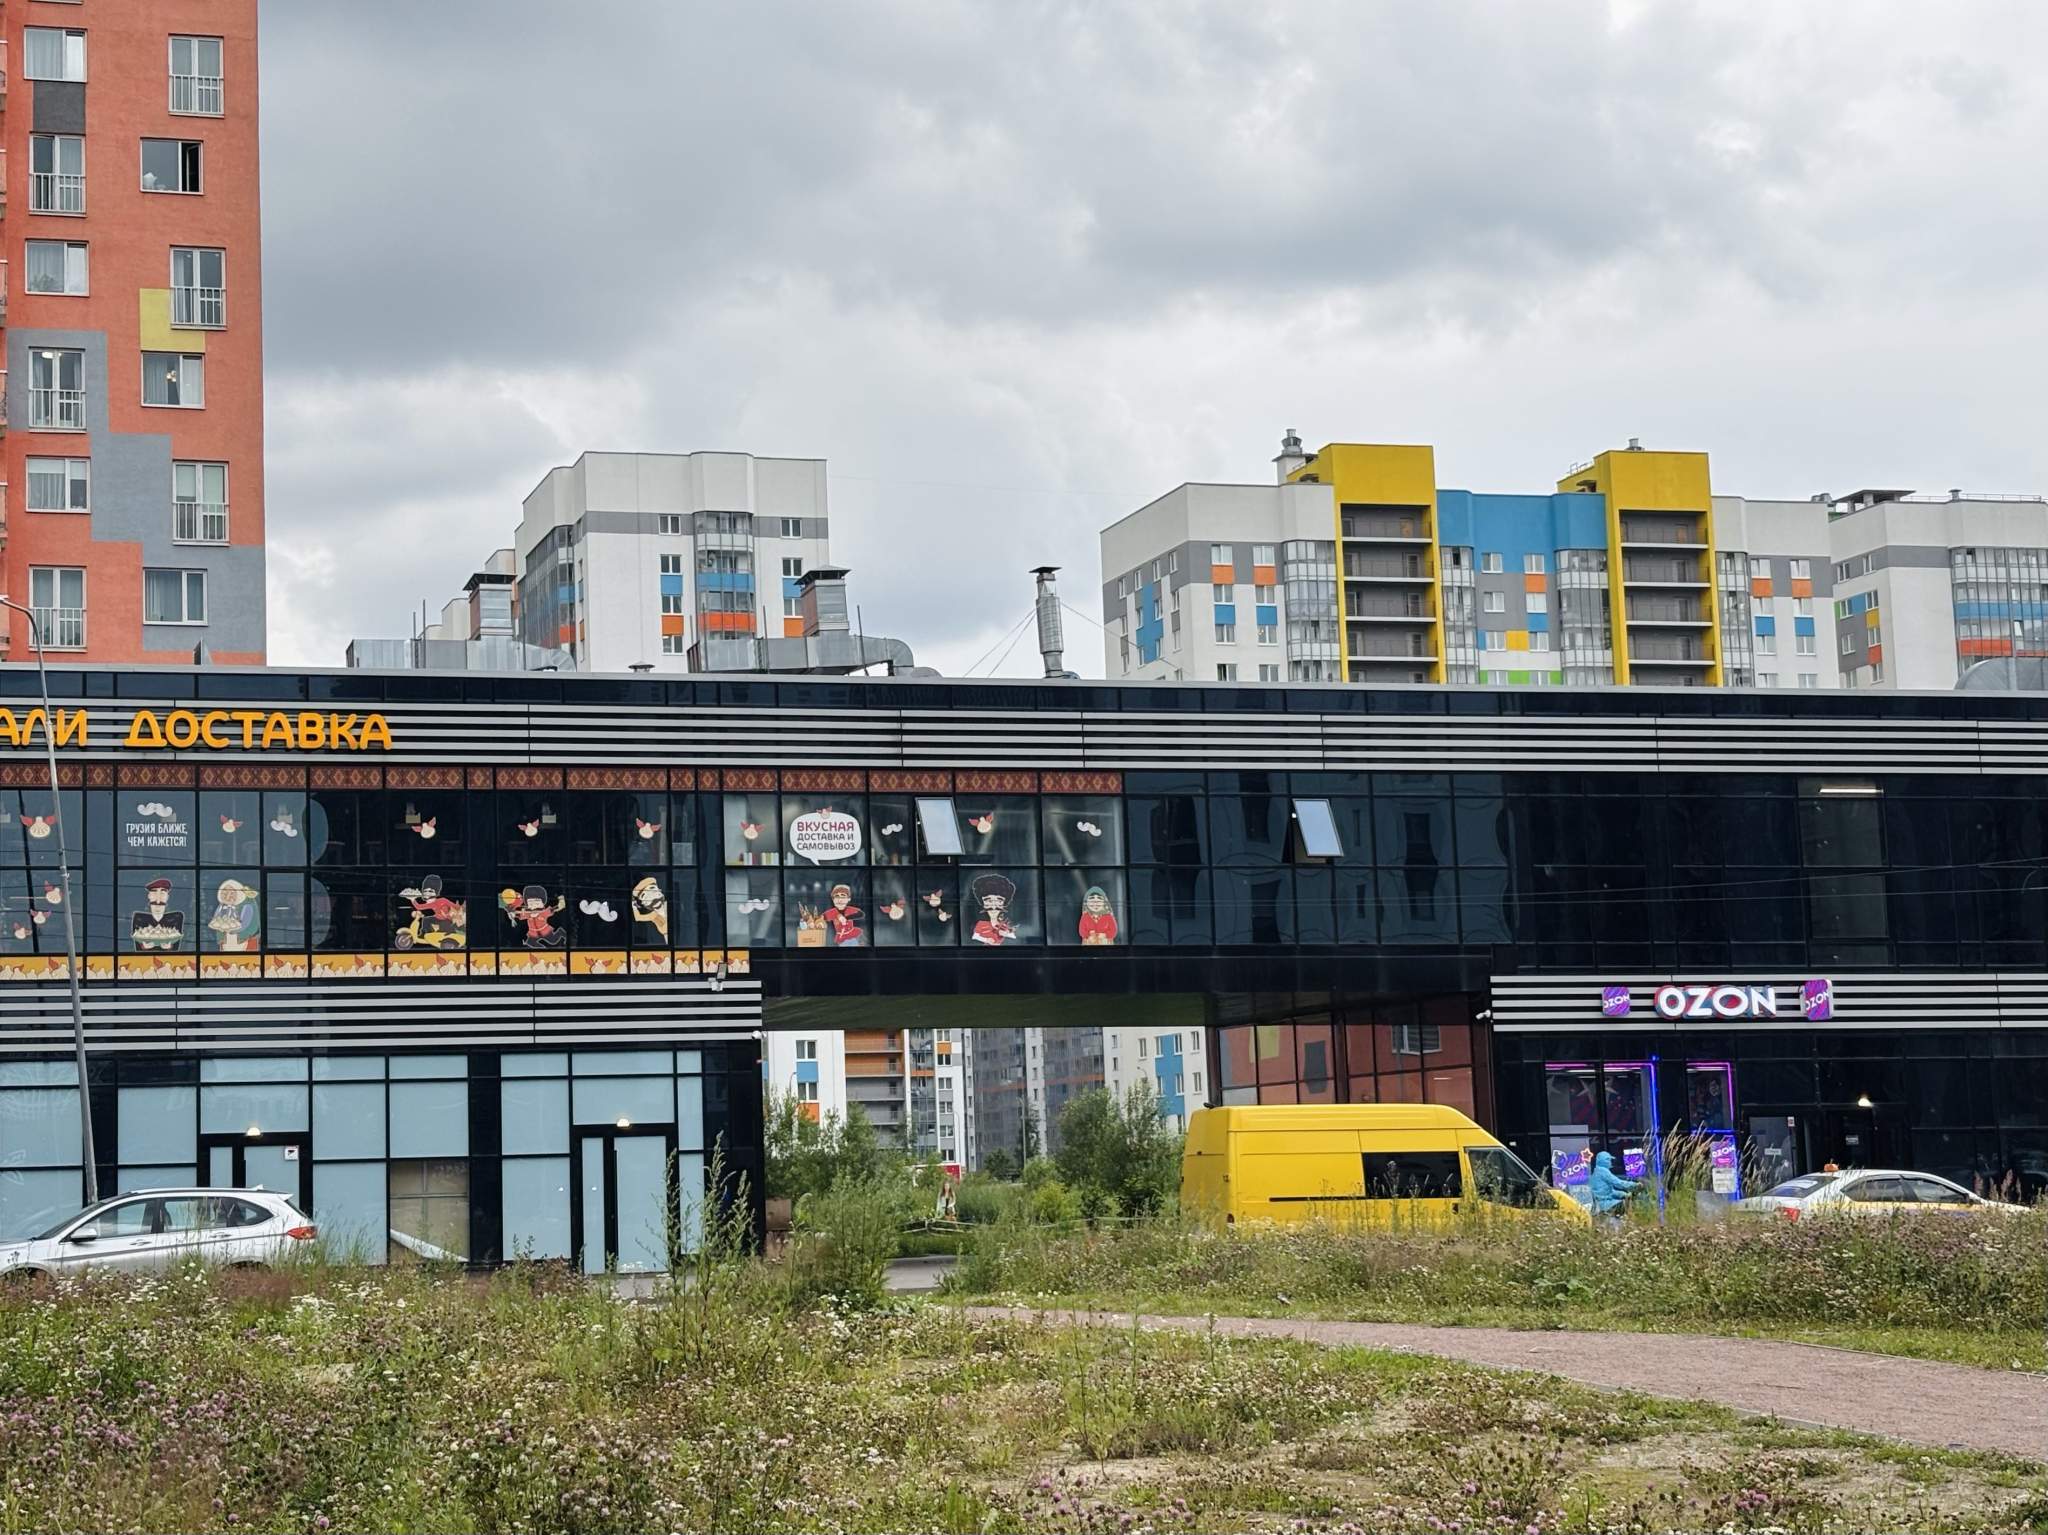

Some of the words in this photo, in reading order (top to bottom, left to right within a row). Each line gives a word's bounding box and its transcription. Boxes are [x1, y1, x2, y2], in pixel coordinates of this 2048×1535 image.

[123, 710, 392, 750] ДОСТАВКА
[126, 823, 156, 834] ГРУЗИЯ
[158, 823, 188, 835] БЛИЖЕ,
[797, 821, 854, 832] ВКУСНАЯ
[127, 836, 145, 847] ЧЕМ
[147, 836, 187, 847] КАЖЕТСЯ!
[797, 832, 846, 842] ДОСТАВКА
[847, 833, 854, 841] И
[796, 842, 855, 851] САМОВЫВОЗ
[1603, 993, 1631, 1009] OZON
[1658, 986, 1777, 1017] OZON
[1561, 1161, 1588, 1178] OZON
